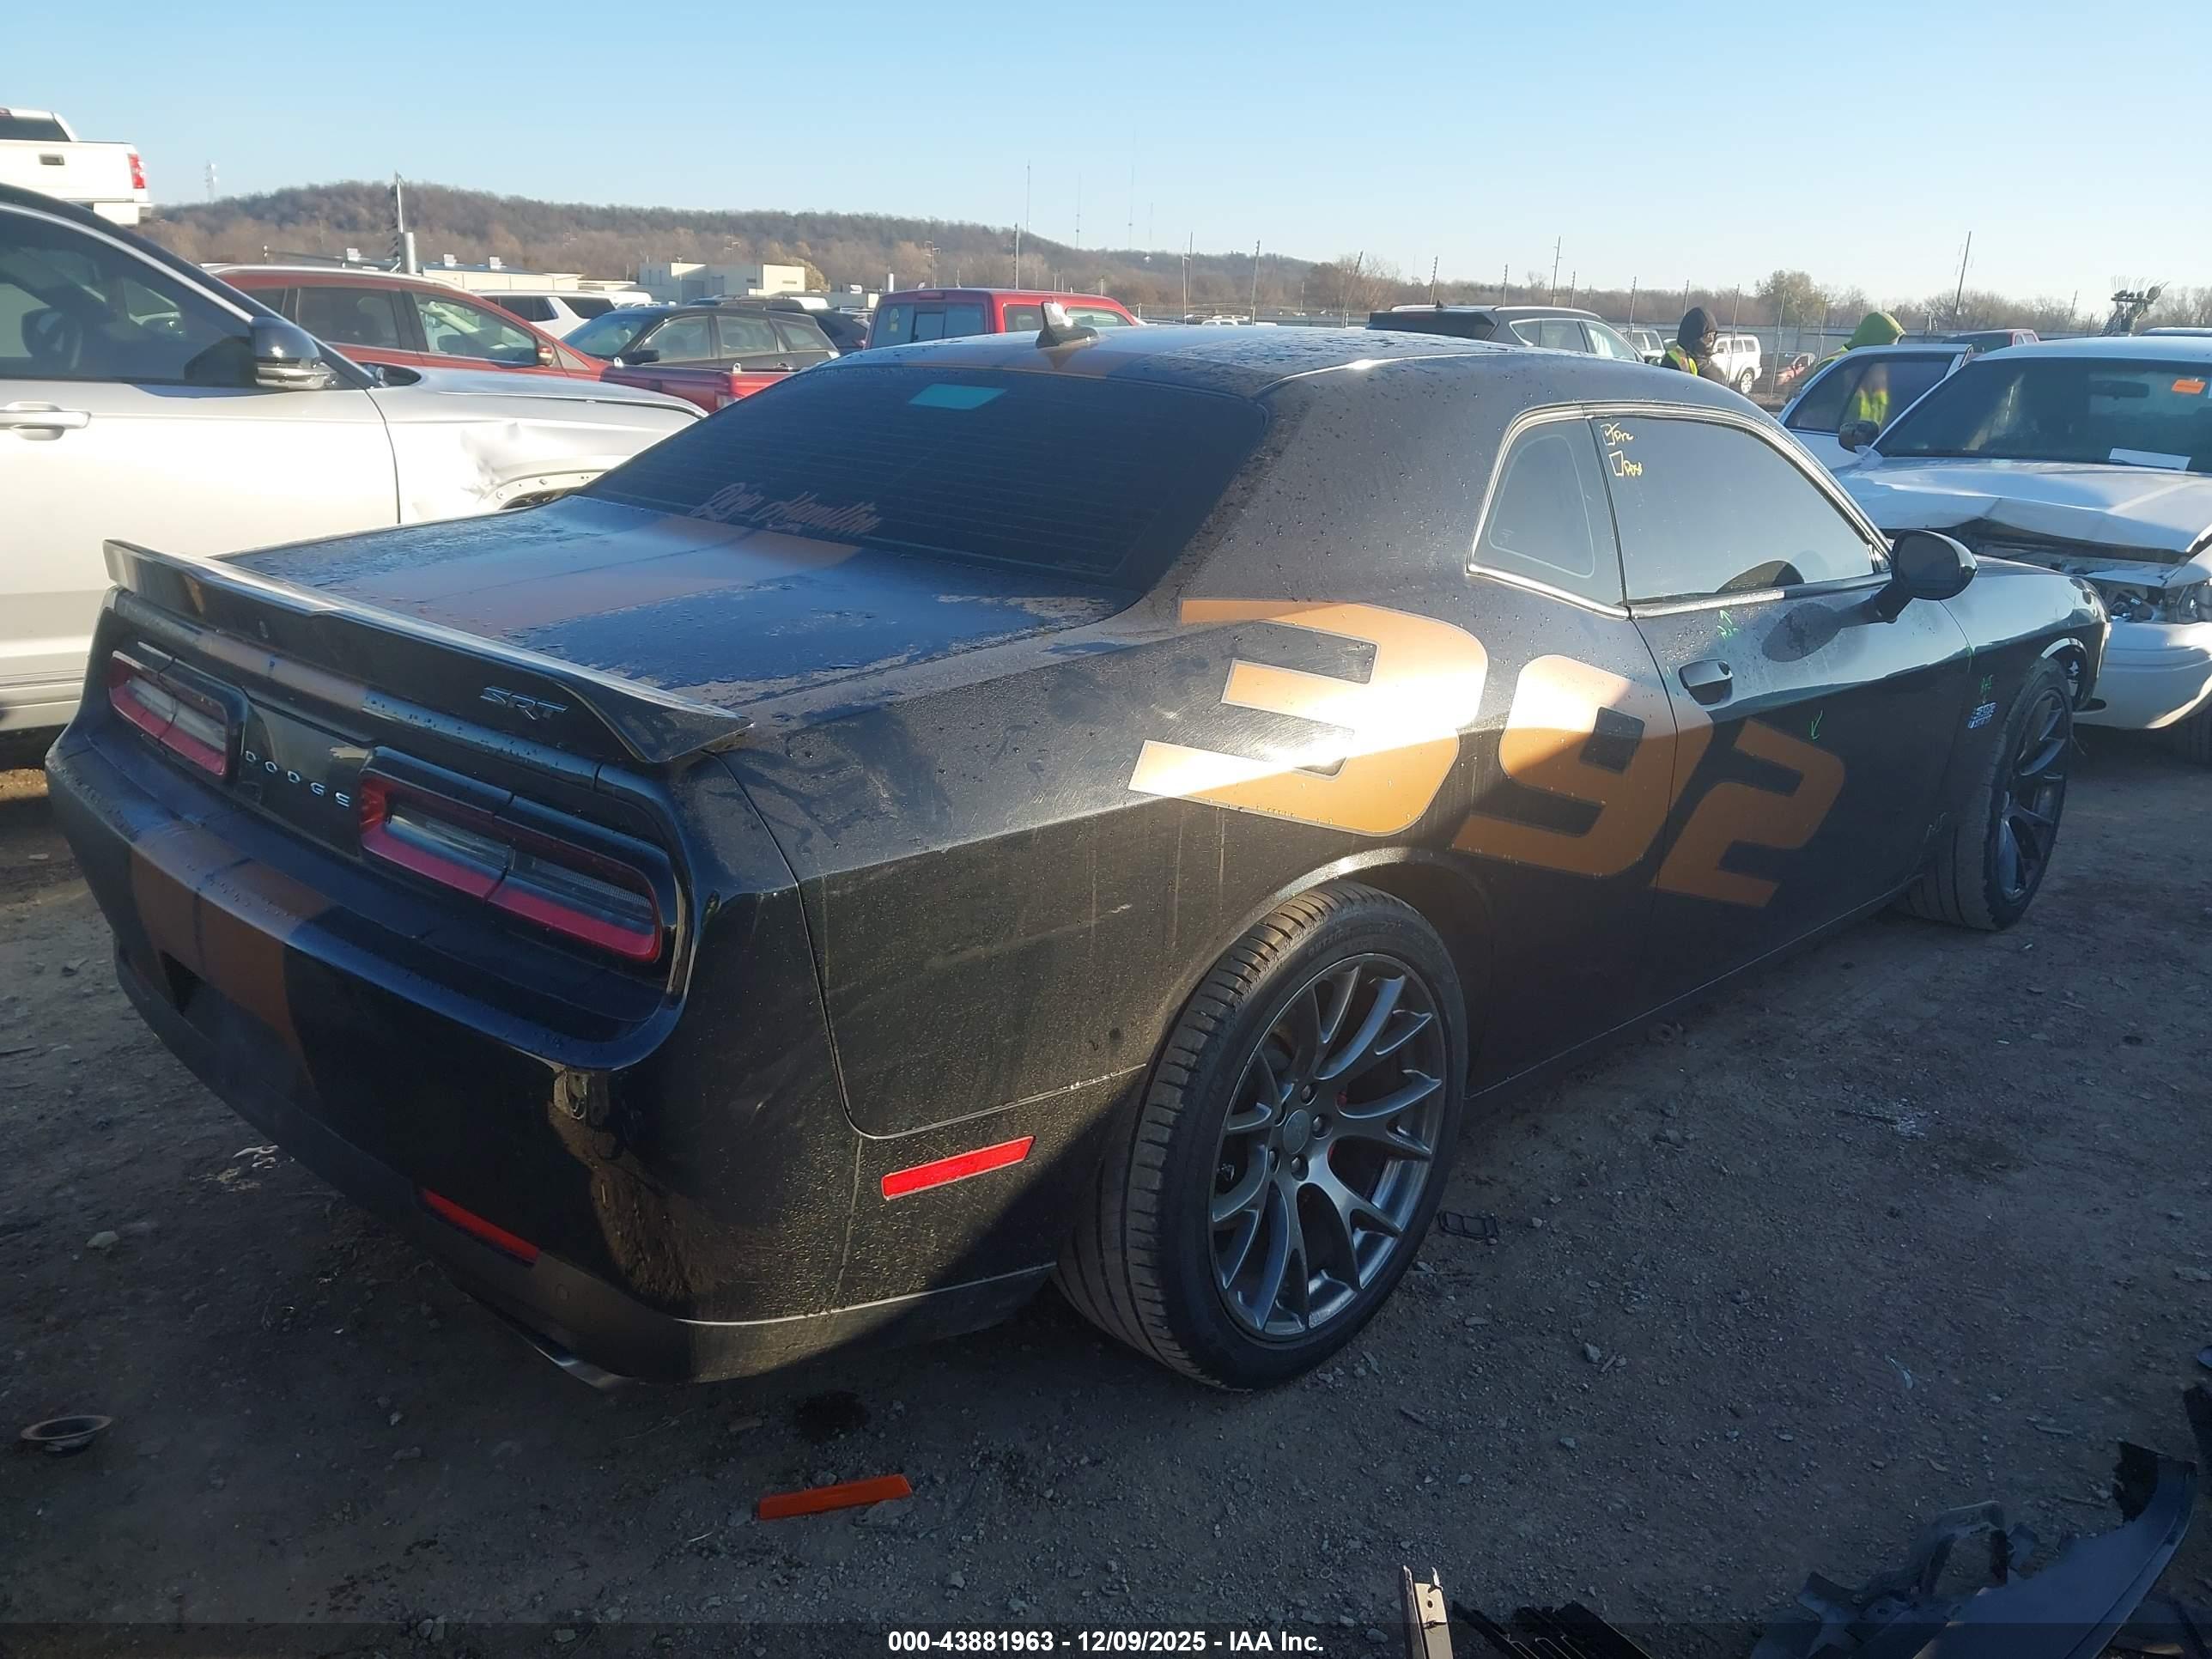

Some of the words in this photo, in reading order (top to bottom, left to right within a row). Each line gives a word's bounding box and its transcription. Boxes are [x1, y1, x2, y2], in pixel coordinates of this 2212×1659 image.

[481, 686, 568, 720] SRT
[246, 750, 350, 807] DODGE
[1127, 599, 1846, 908] 392
